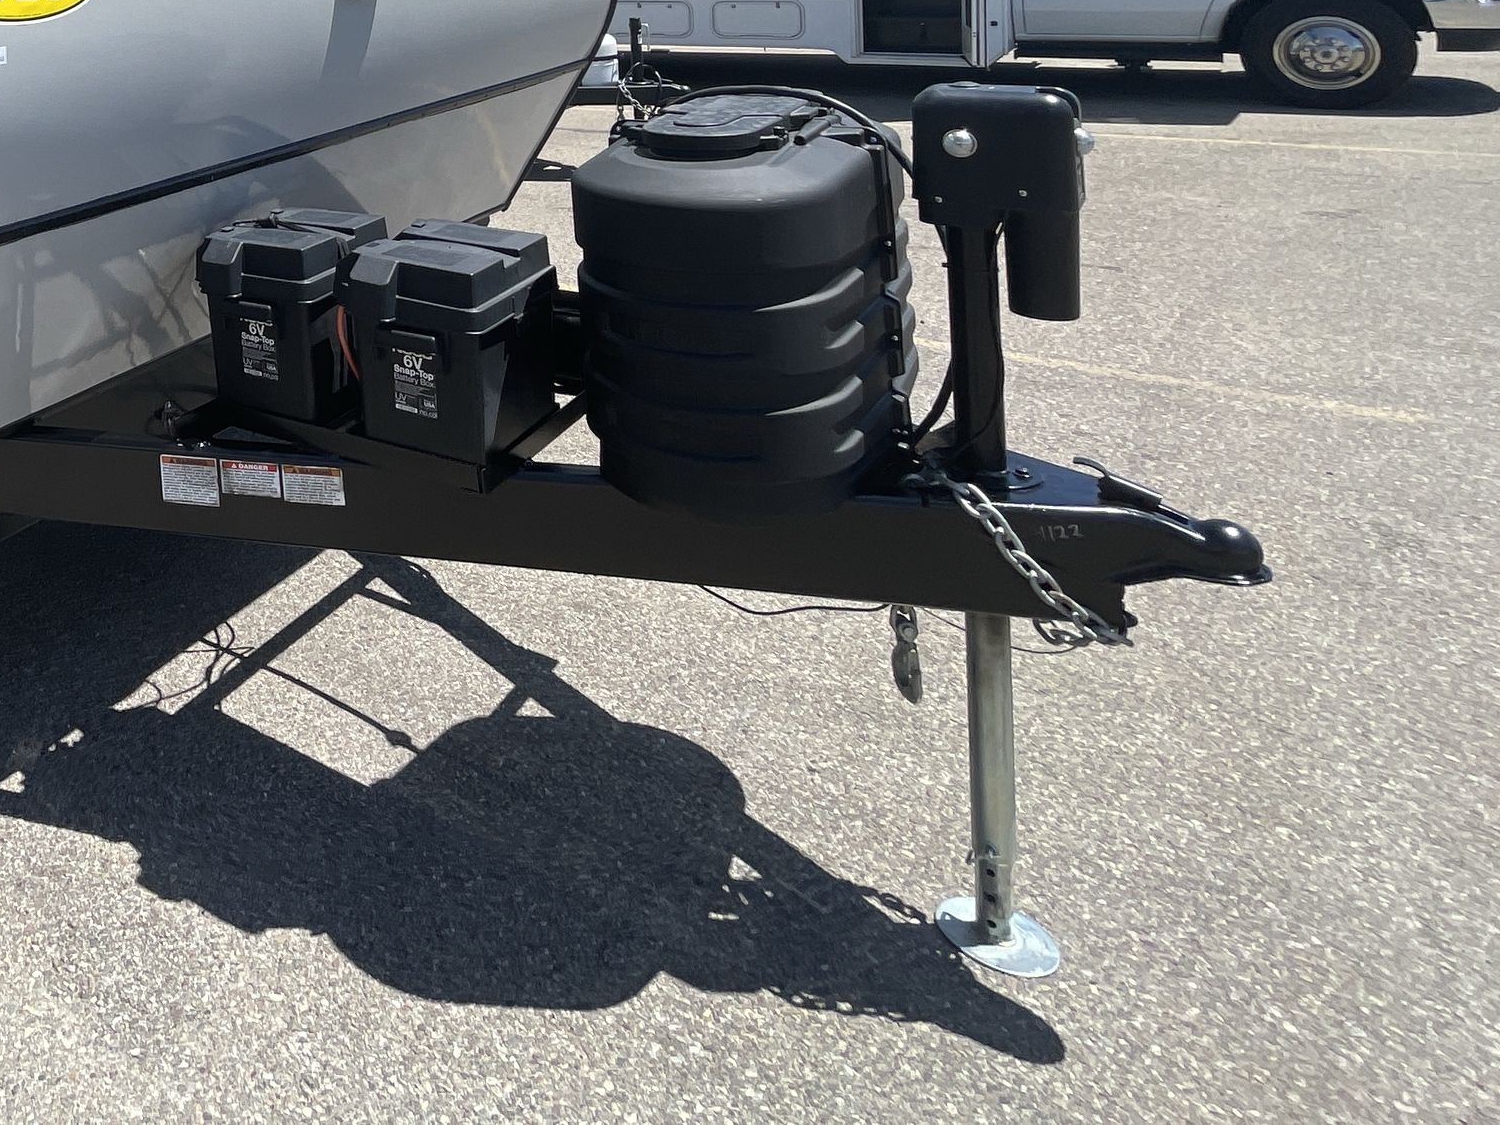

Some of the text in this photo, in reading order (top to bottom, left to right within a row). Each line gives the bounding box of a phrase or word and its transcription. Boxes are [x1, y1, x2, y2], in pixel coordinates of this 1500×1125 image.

[249, 323, 265, 335] 6V
[241, 331, 275, 346] Snap-Top
[403, 355, 423, 371] 6V
[393, 363, 434, 382] Snap-Top
[238, 463, 269, 471] DANGER
